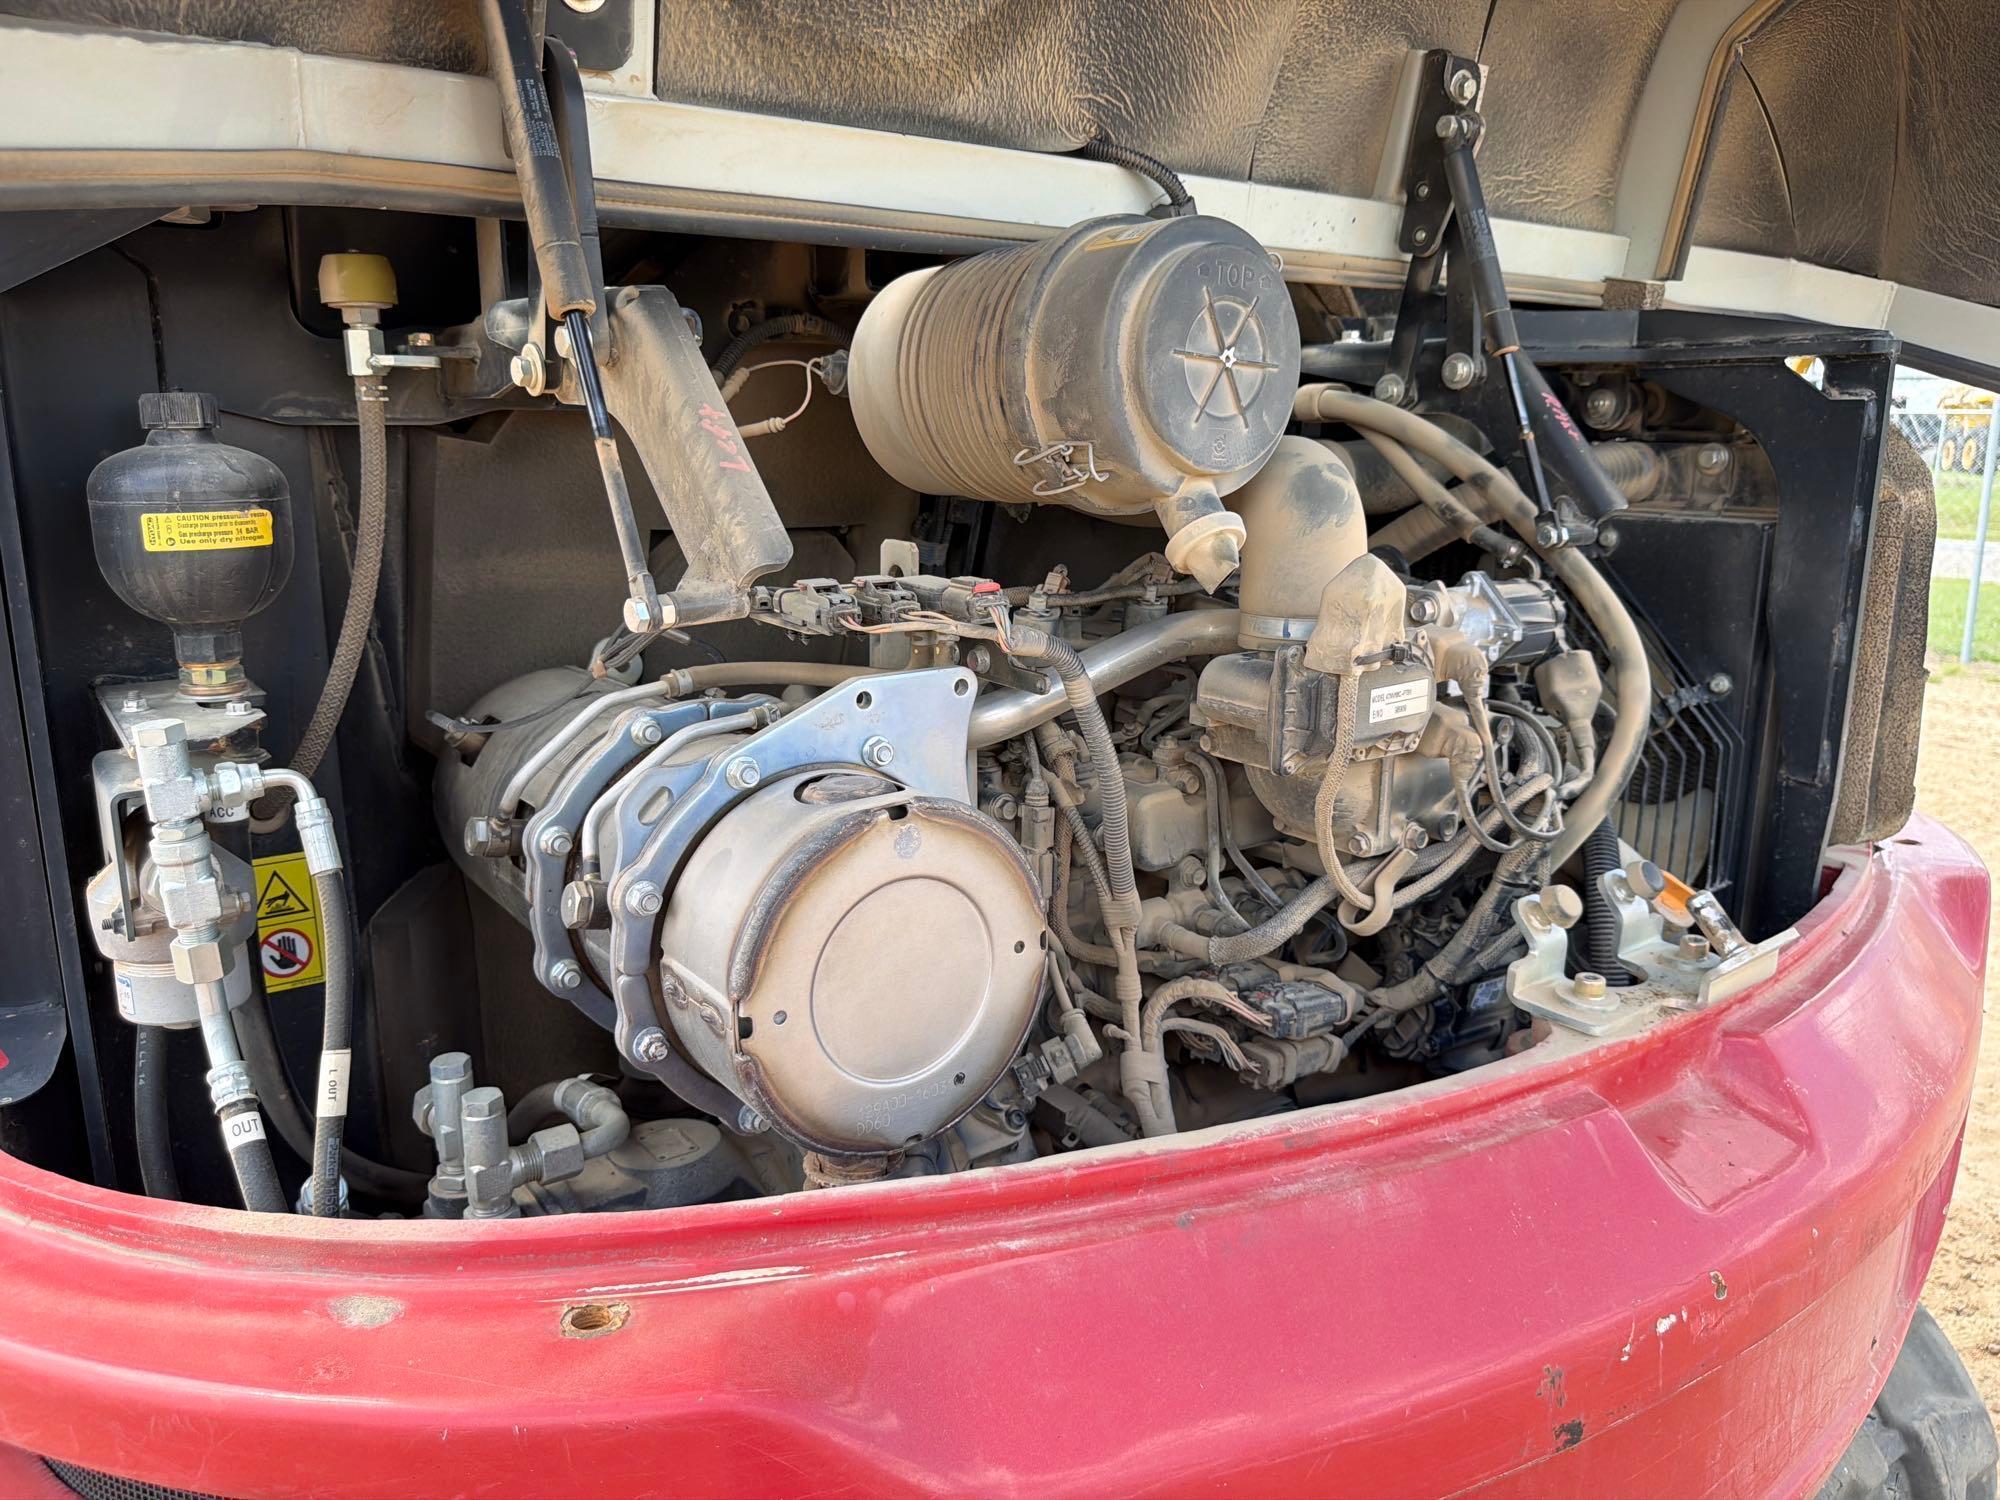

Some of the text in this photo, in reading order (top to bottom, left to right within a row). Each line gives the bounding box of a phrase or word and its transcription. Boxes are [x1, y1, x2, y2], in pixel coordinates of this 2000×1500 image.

[1215, 260, 1255, 289] TOP
[176, 514, 210, 522] CAUTION
[199, 536, 217, 544] only
[219, 535, 233, 543] dry
[235, 534, 265, 542] nitrogen
[210, 806, 234, 818] ACC
[328, 1081, 338, 1101] OUT
[232, 1118, 260, 1137] OUT
[327, 1144, 340, 1179] Parker
